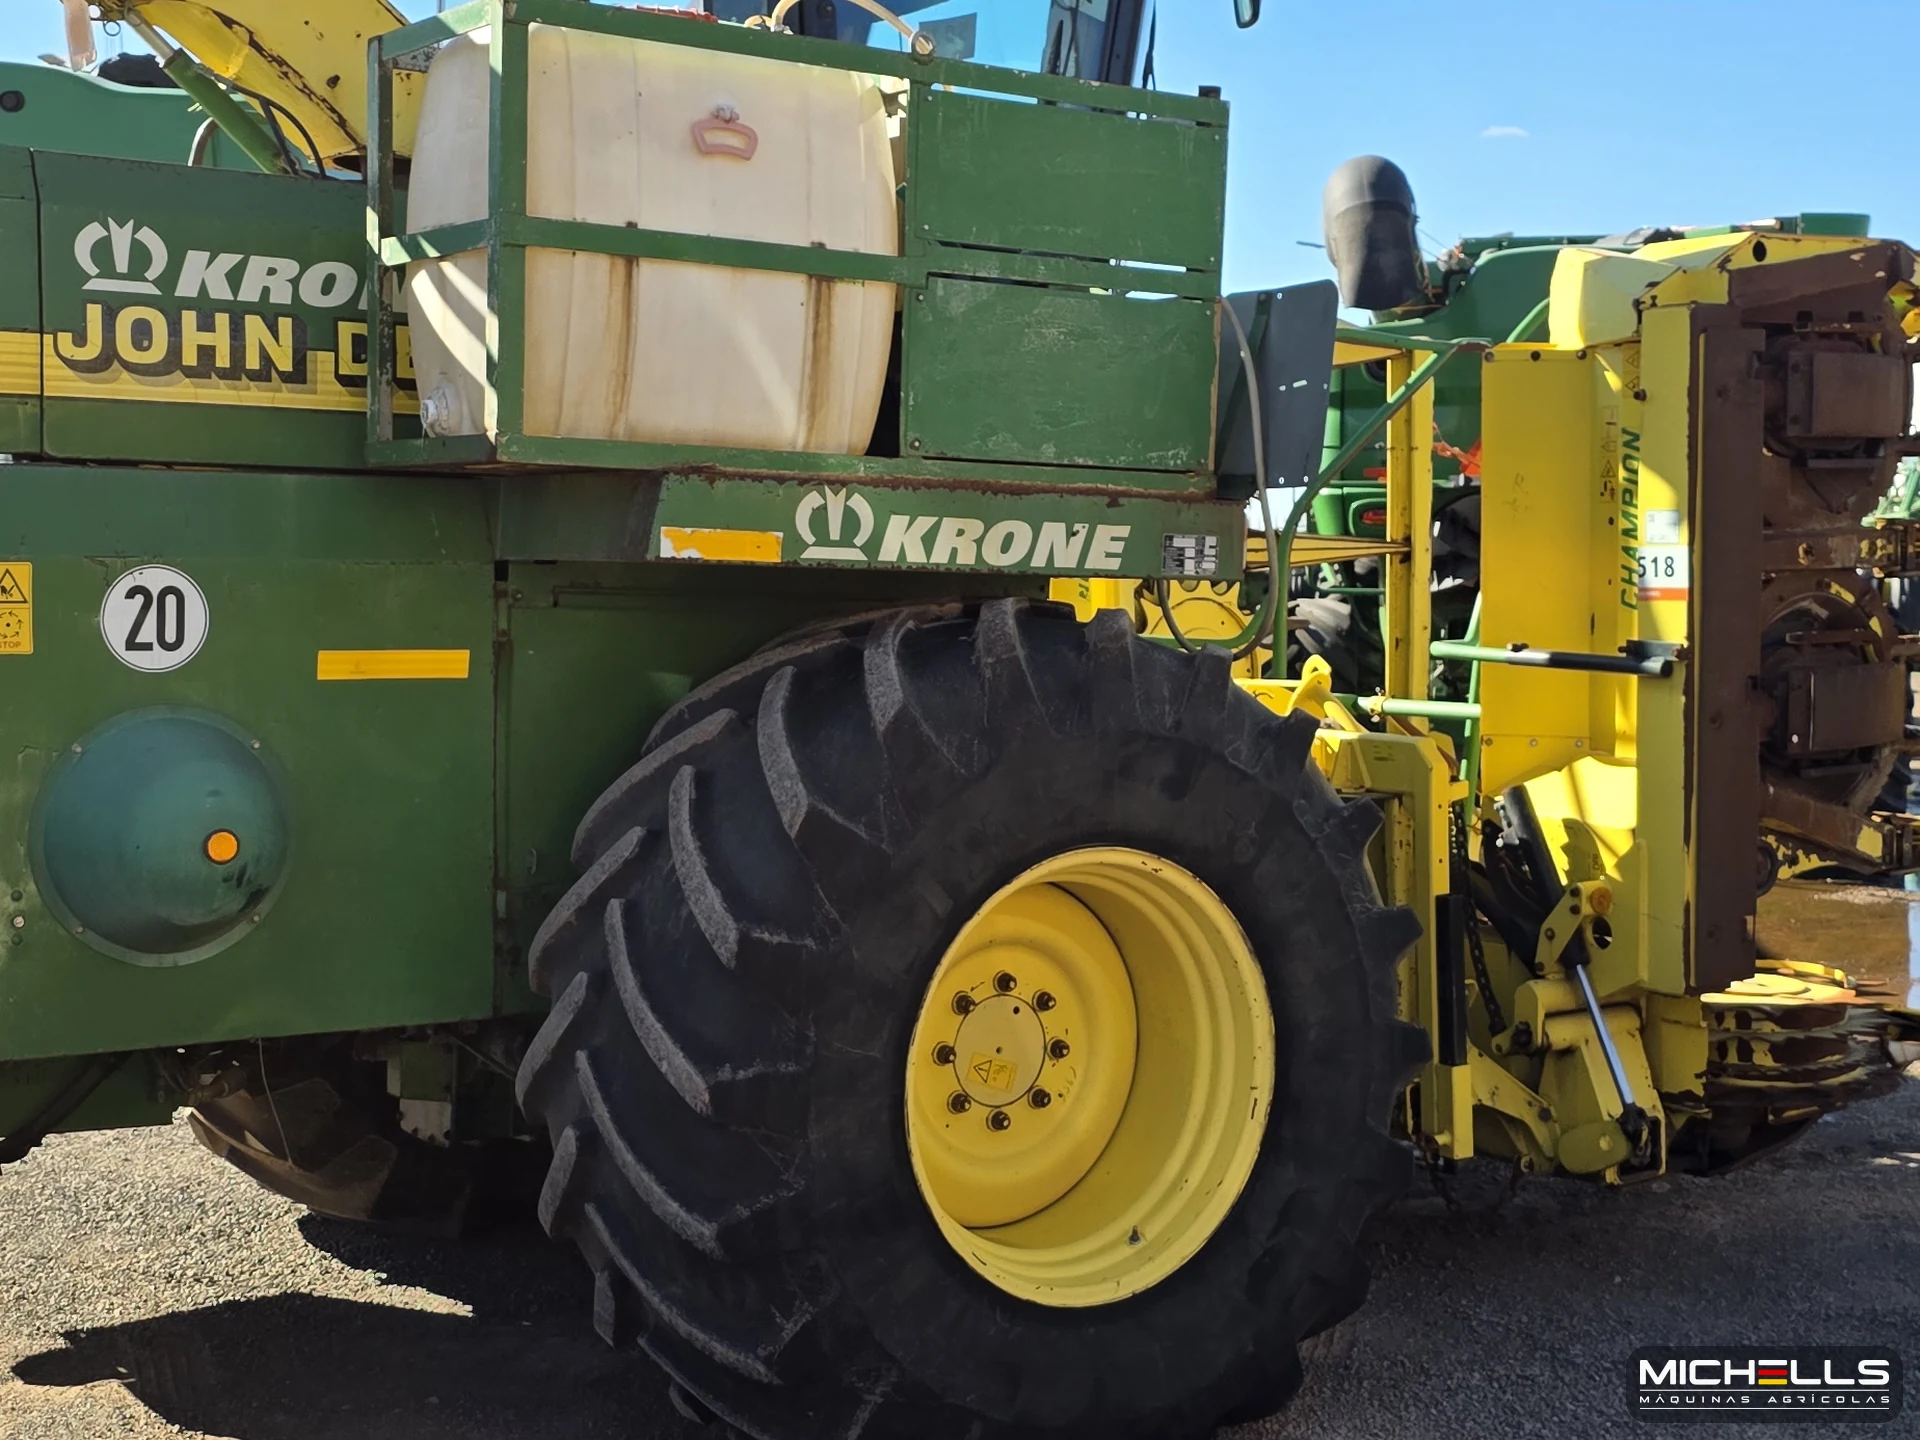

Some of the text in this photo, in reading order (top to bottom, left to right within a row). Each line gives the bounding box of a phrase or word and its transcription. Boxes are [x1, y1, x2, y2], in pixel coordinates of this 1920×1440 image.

[57, 303, 293, 372] JOHN
[877, 514, 1131, 570] KRONE
[1620, 427, 1642, 610] CHAMPION
[124, 585, 186, 652] 20
